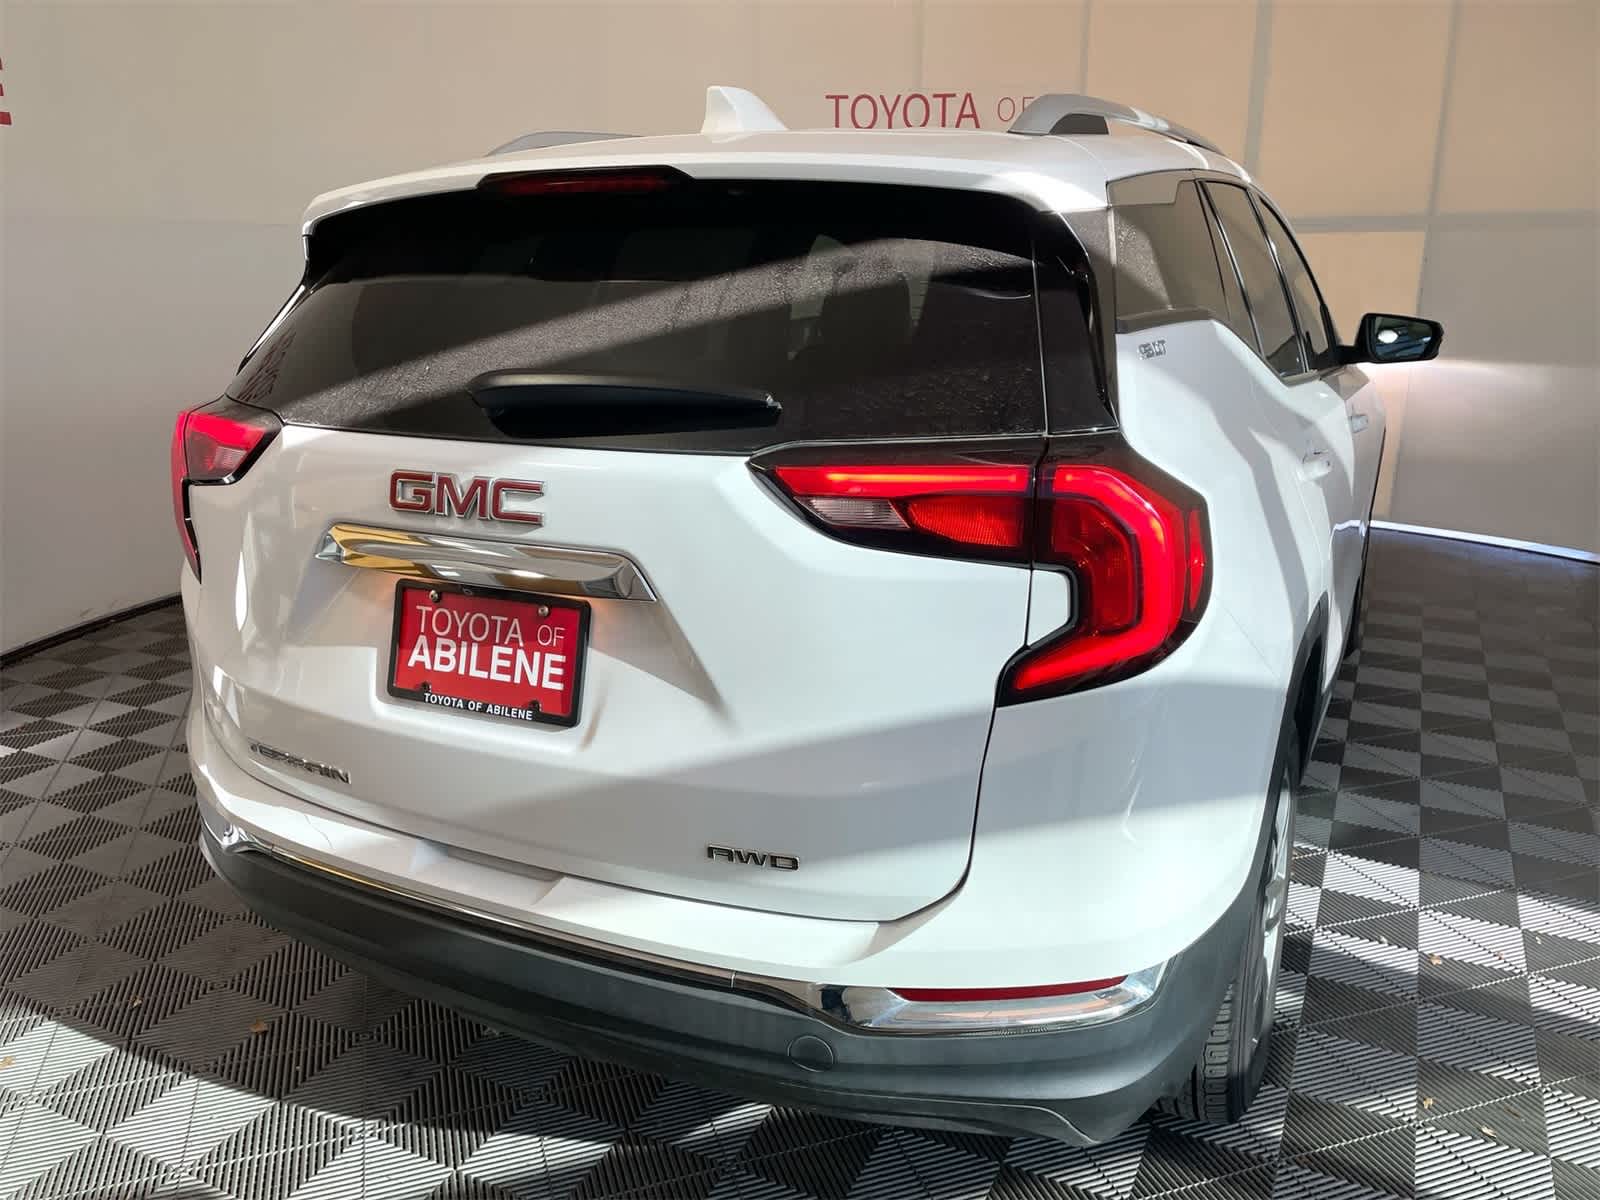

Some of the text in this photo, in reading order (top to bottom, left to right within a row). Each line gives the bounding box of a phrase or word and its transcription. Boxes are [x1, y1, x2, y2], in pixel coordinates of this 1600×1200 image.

[825, 92, 980, 129] TOYOTA
[389, 469, 545, 527] GMC
[416, 605, 566, 647] TOYOTA OF
[407, 634, 567, 691] ABILENE
[423, 692, 533, 721] TOYOTA OF ABILENE
[707, 844, 800, 872] AWD
